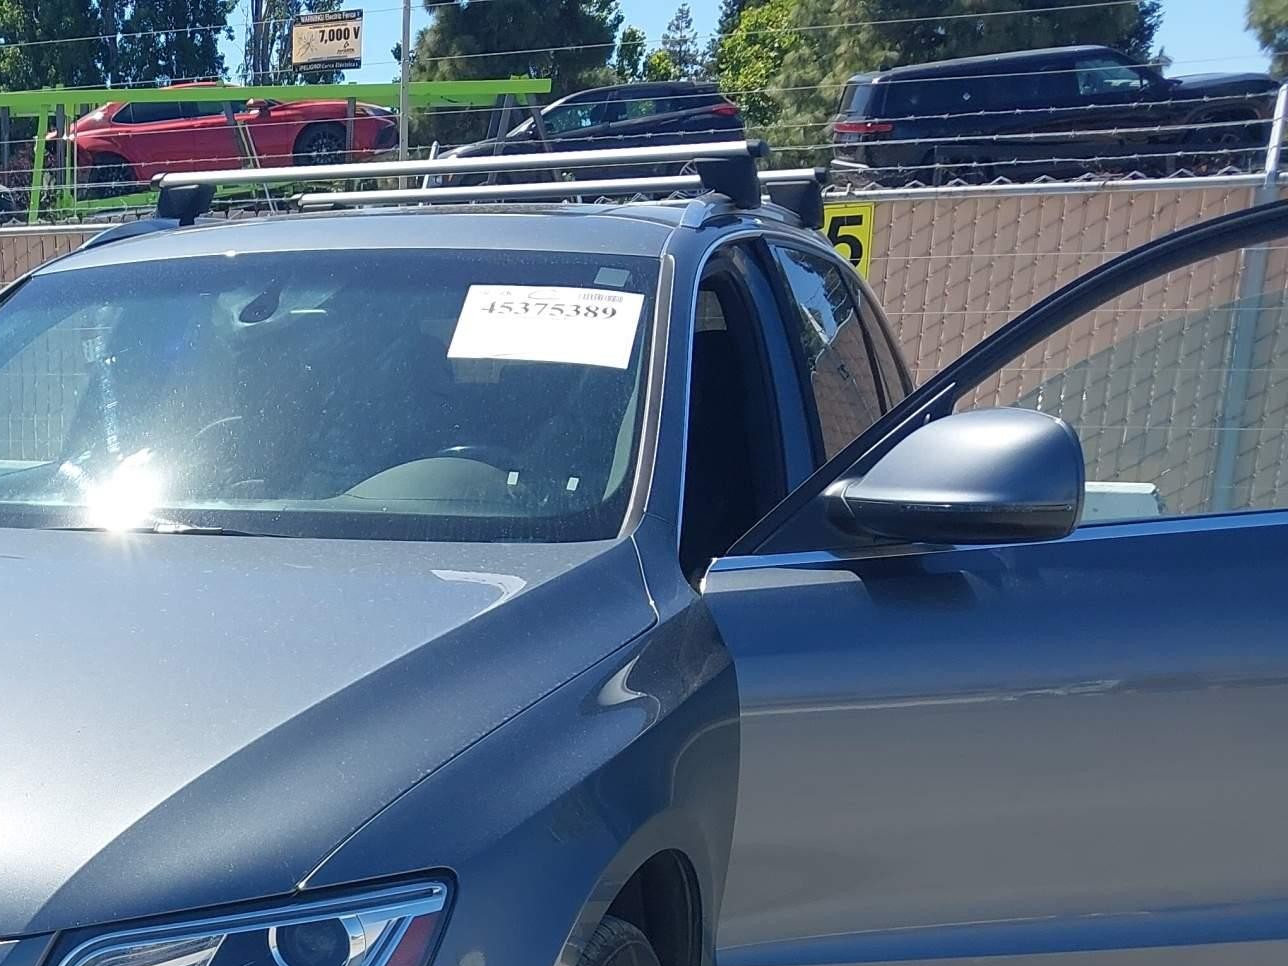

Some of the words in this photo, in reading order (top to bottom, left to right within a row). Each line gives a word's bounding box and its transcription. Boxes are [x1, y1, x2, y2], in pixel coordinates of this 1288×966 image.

[319, 27, 350, 44] 7,000
[353, 26, 360, 39] V
[827, 214, 863, 268] 5
[480, 301, 617, 319] 45375389
